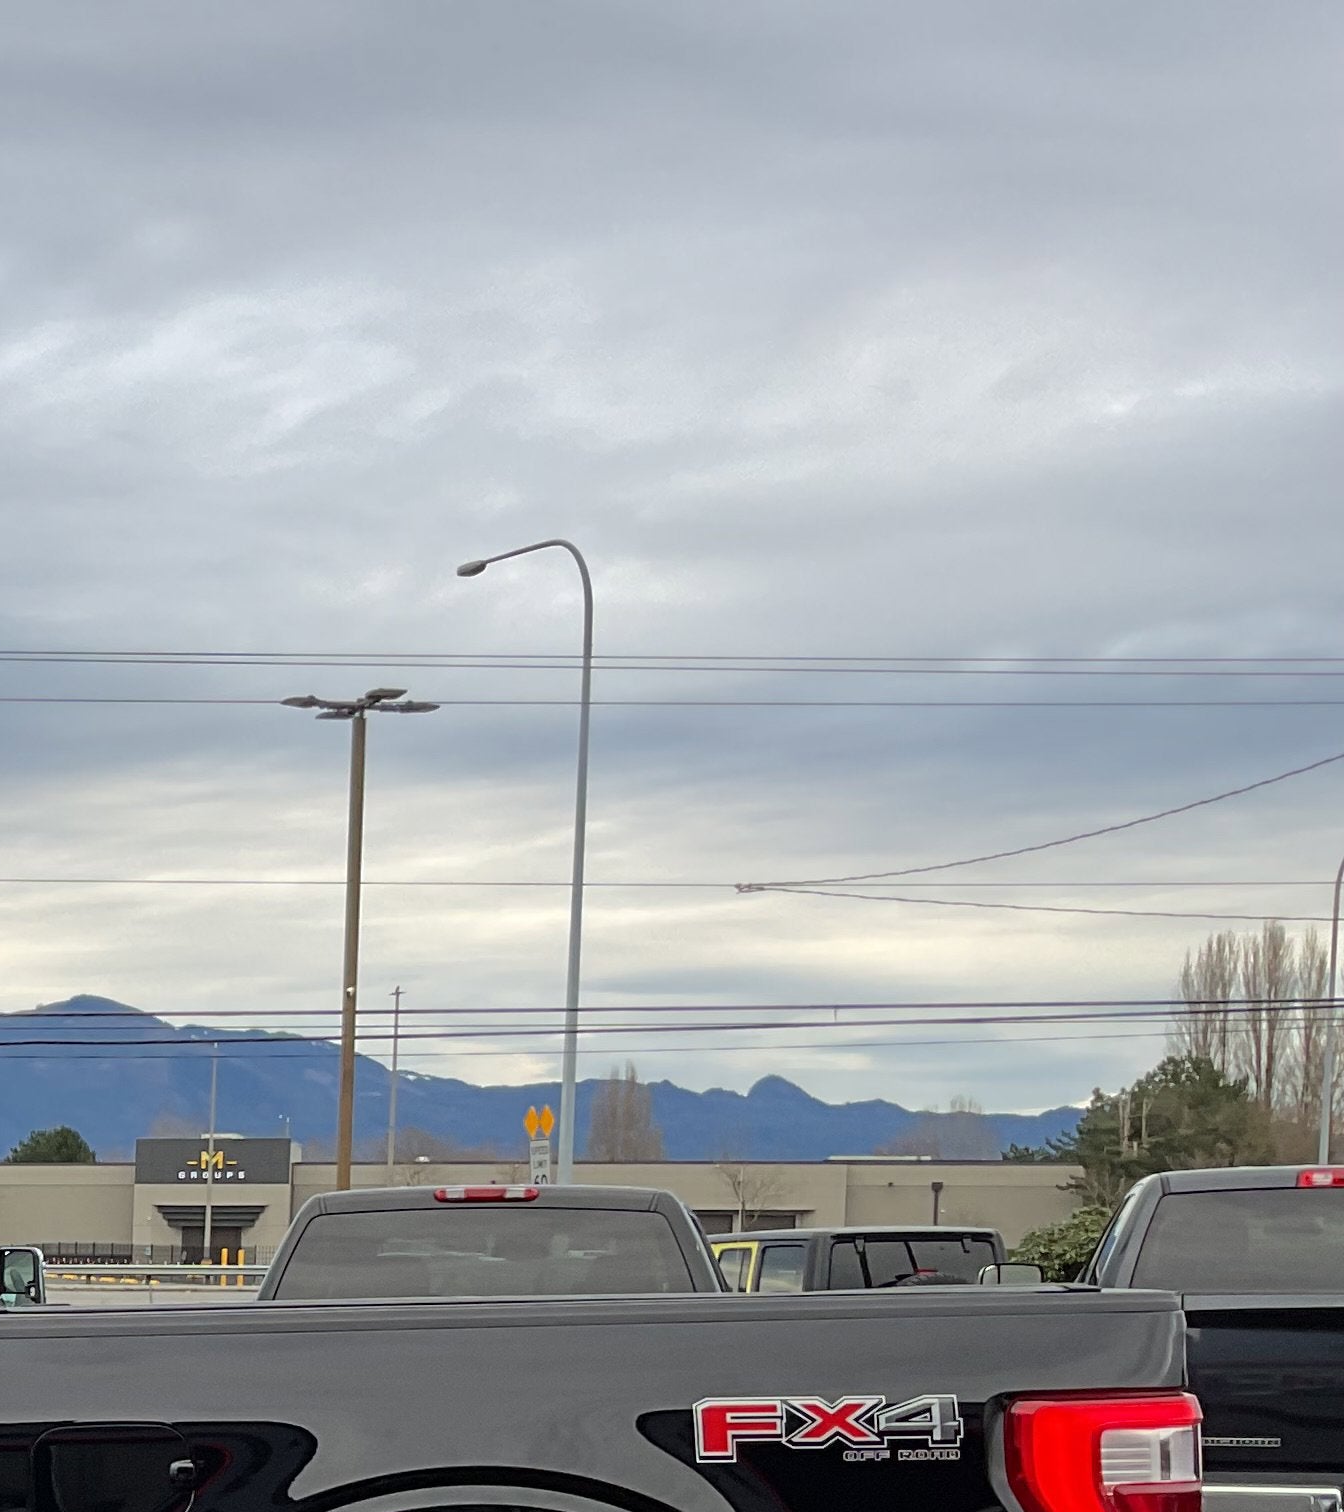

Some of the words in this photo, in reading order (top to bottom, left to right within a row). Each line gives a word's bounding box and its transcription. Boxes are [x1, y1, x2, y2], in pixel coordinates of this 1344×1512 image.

[200, 1151, 224, 1170] M
[177, 1171, 246, 1180] GROUPS
[692, 1394, 964, 1463] FX4
[843, 1450, 890, 1461] OFF
[897, 1449, 961, 1461] ROAD
